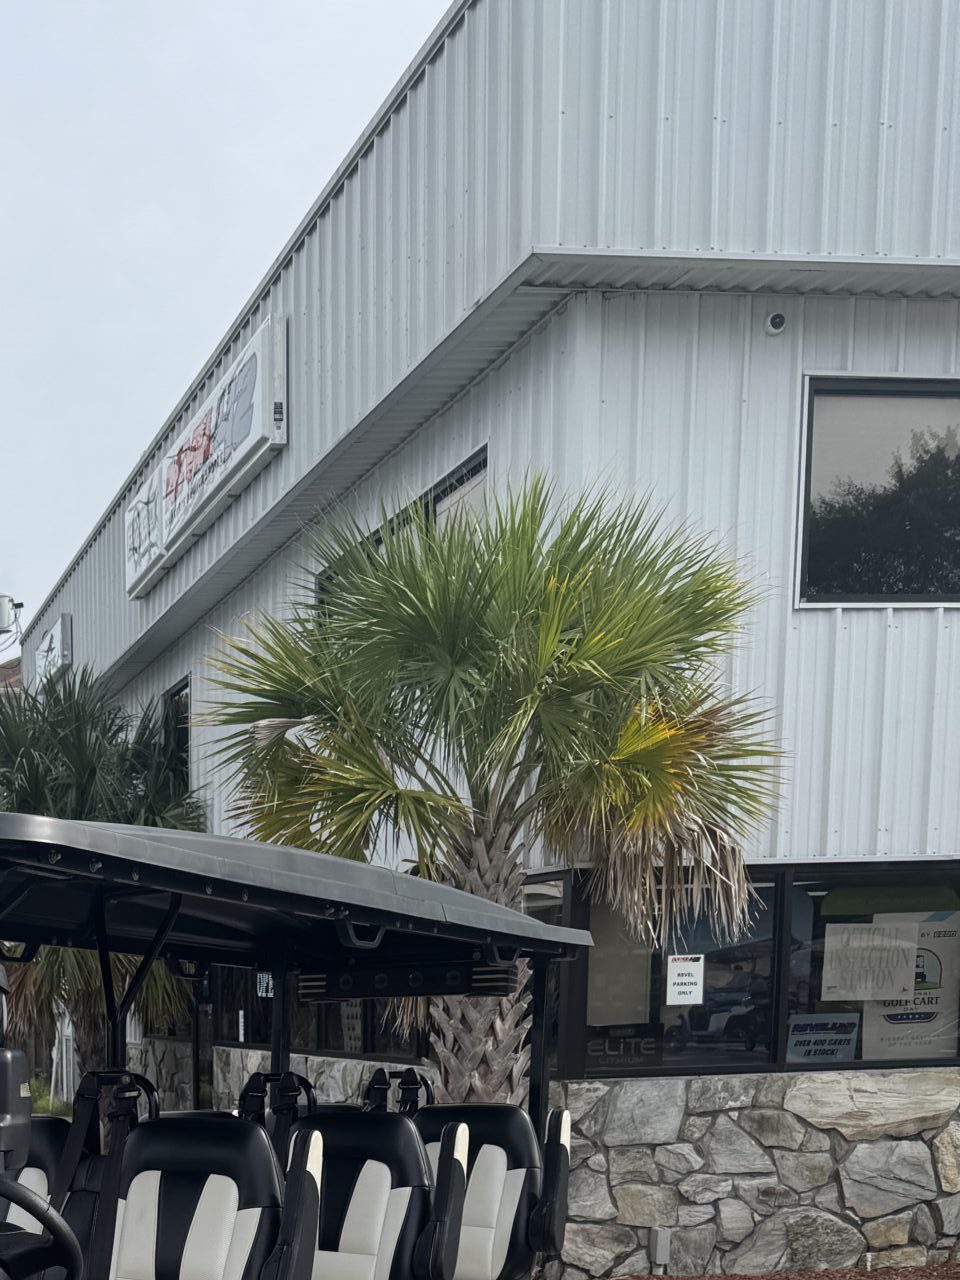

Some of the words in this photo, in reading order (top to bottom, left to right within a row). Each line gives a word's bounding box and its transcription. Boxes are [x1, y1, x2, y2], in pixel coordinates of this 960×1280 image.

[829, 947, 911, 970] INSPECTION
[256, 972, 274, 998] OPE
[840, 969, 896, 993] STATION
[883, 999, 911, 1007] GOLF
[913, 996, 940, 1006] CART
